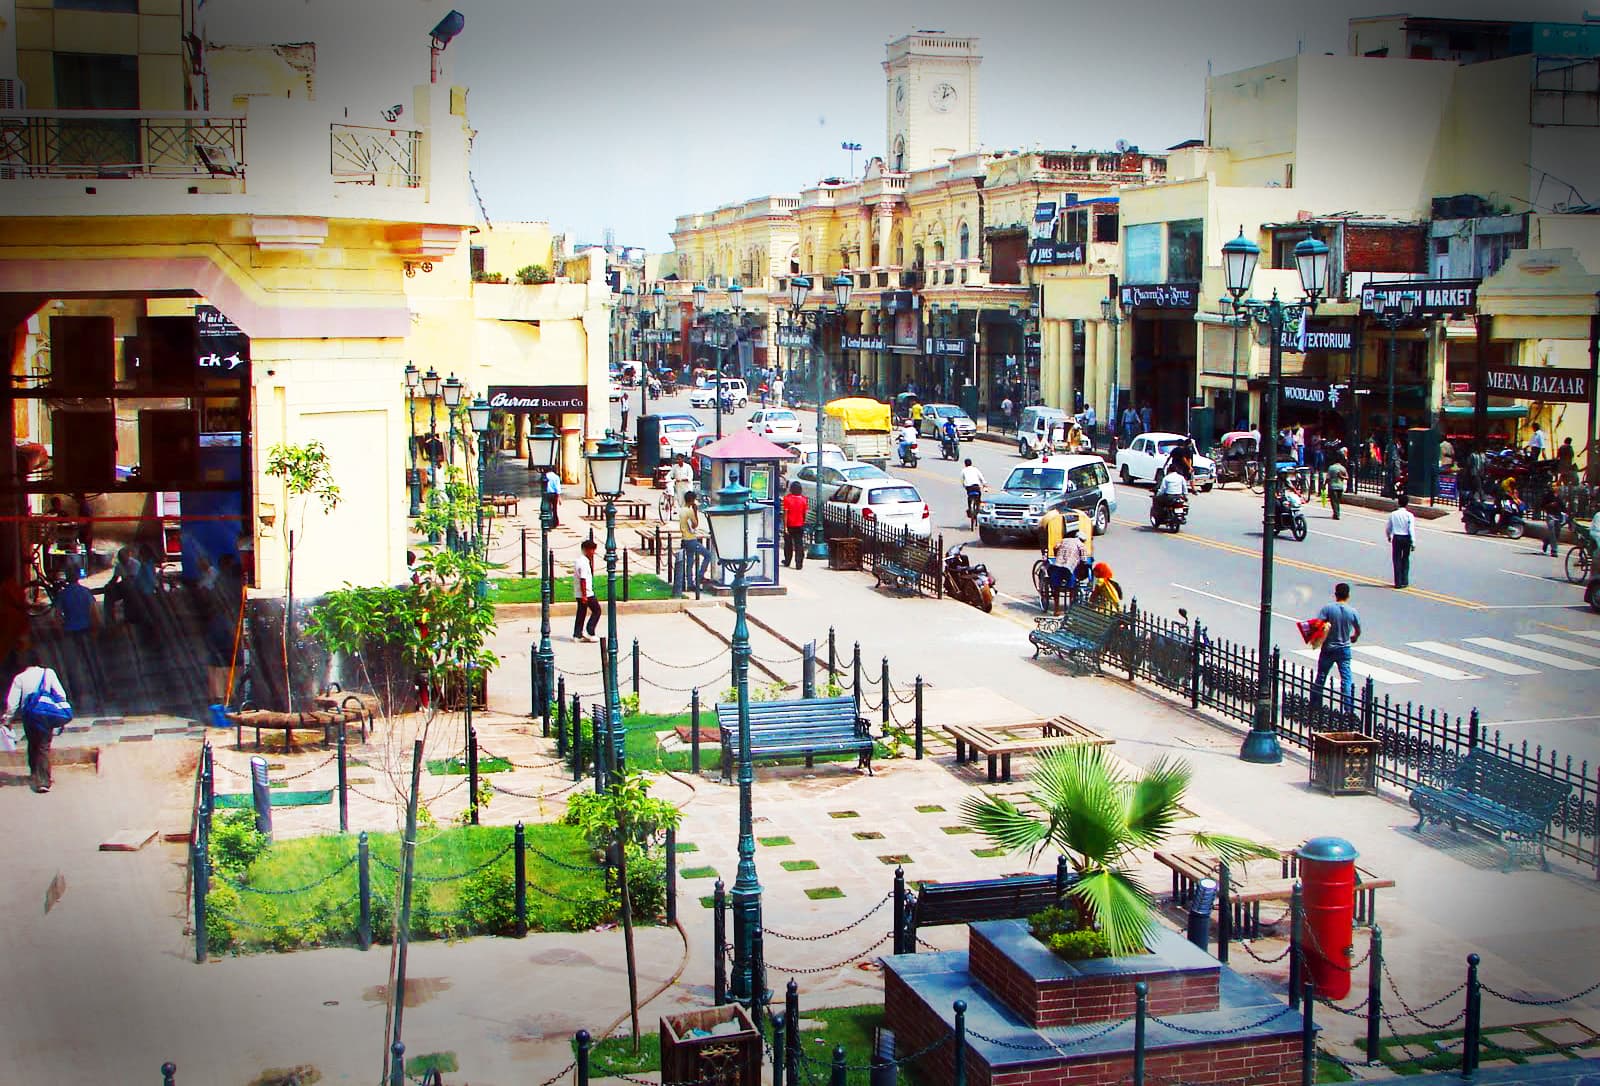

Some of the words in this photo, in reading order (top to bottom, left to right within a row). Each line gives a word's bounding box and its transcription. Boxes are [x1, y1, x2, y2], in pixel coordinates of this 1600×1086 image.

[1425, 289, 1471, 306] MARKET
[1487, 371, 1528, 391] MEENA
[1532, 375, 1584, 395] BAZAAR
[490, 392, 540, 407] Burma
[1284, 386, 1325, 402] WOODLAND
